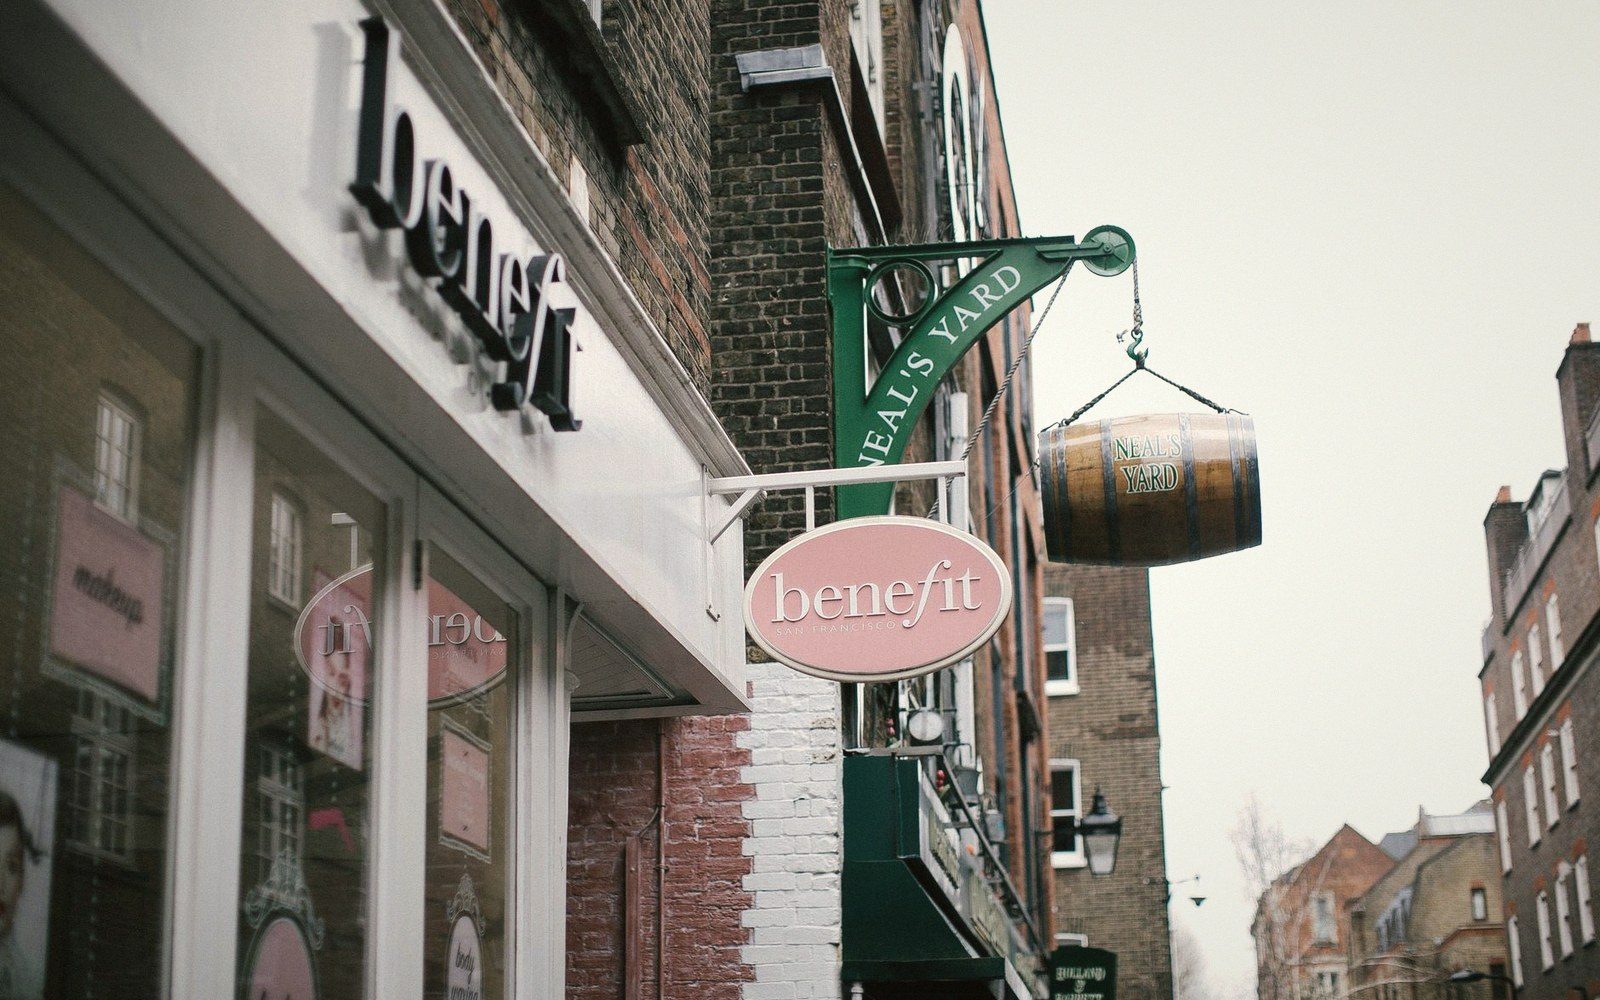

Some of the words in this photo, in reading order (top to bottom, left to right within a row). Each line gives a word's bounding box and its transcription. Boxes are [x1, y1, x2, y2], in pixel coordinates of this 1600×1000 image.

[928, 265, 1021, 345] YARD
[1114, 434, 1182, 461] NEAL'S
[1121, 462, 1178, 493] YARD
[770, 560, 982, 628] benefit
[776, 627, 804, 636] SAN
[812, 621, 896, 634] FRANCISCO
